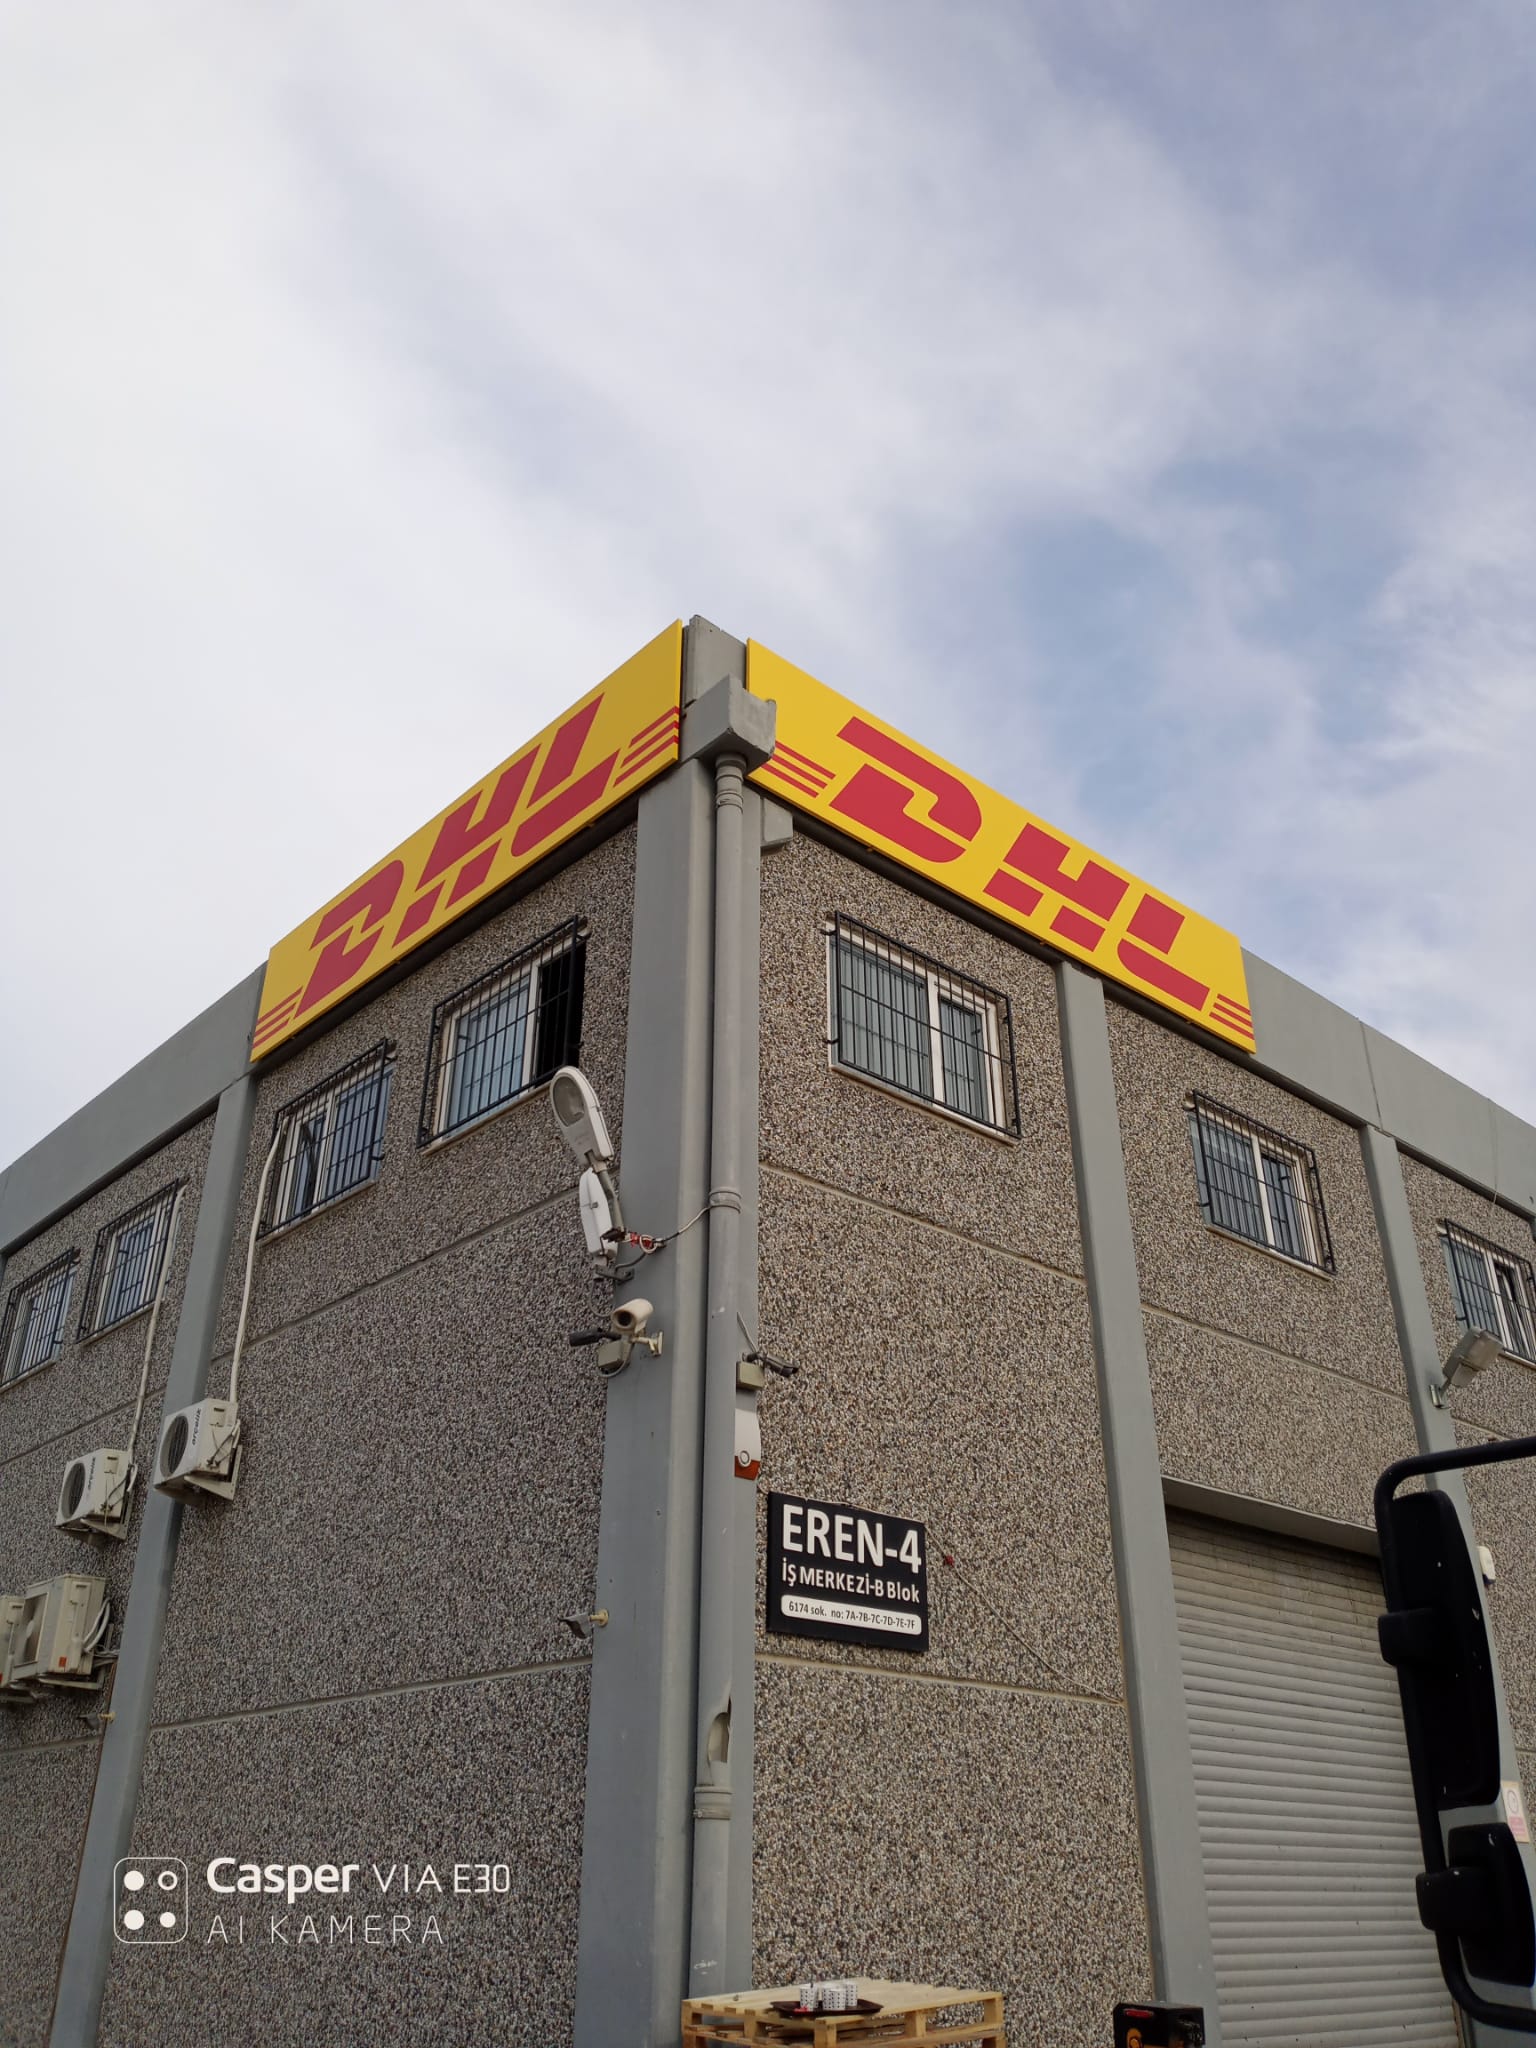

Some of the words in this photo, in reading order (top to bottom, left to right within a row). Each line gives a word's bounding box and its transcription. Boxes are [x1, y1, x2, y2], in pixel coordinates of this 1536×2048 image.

[293, 692, 620, 1020] DHL
[829, 716, 1211, 1012] DHL
[783, 1503, 922, 1574] EREN-4
[782, 1557, 797, 1587] İŞ
[887, 1580, 920, 1603] Blok
[788, 1600, 809, 1614] 6174
[810, 1605, 827, 1617] sok.
[831, 1609, 844, 1619] no:
